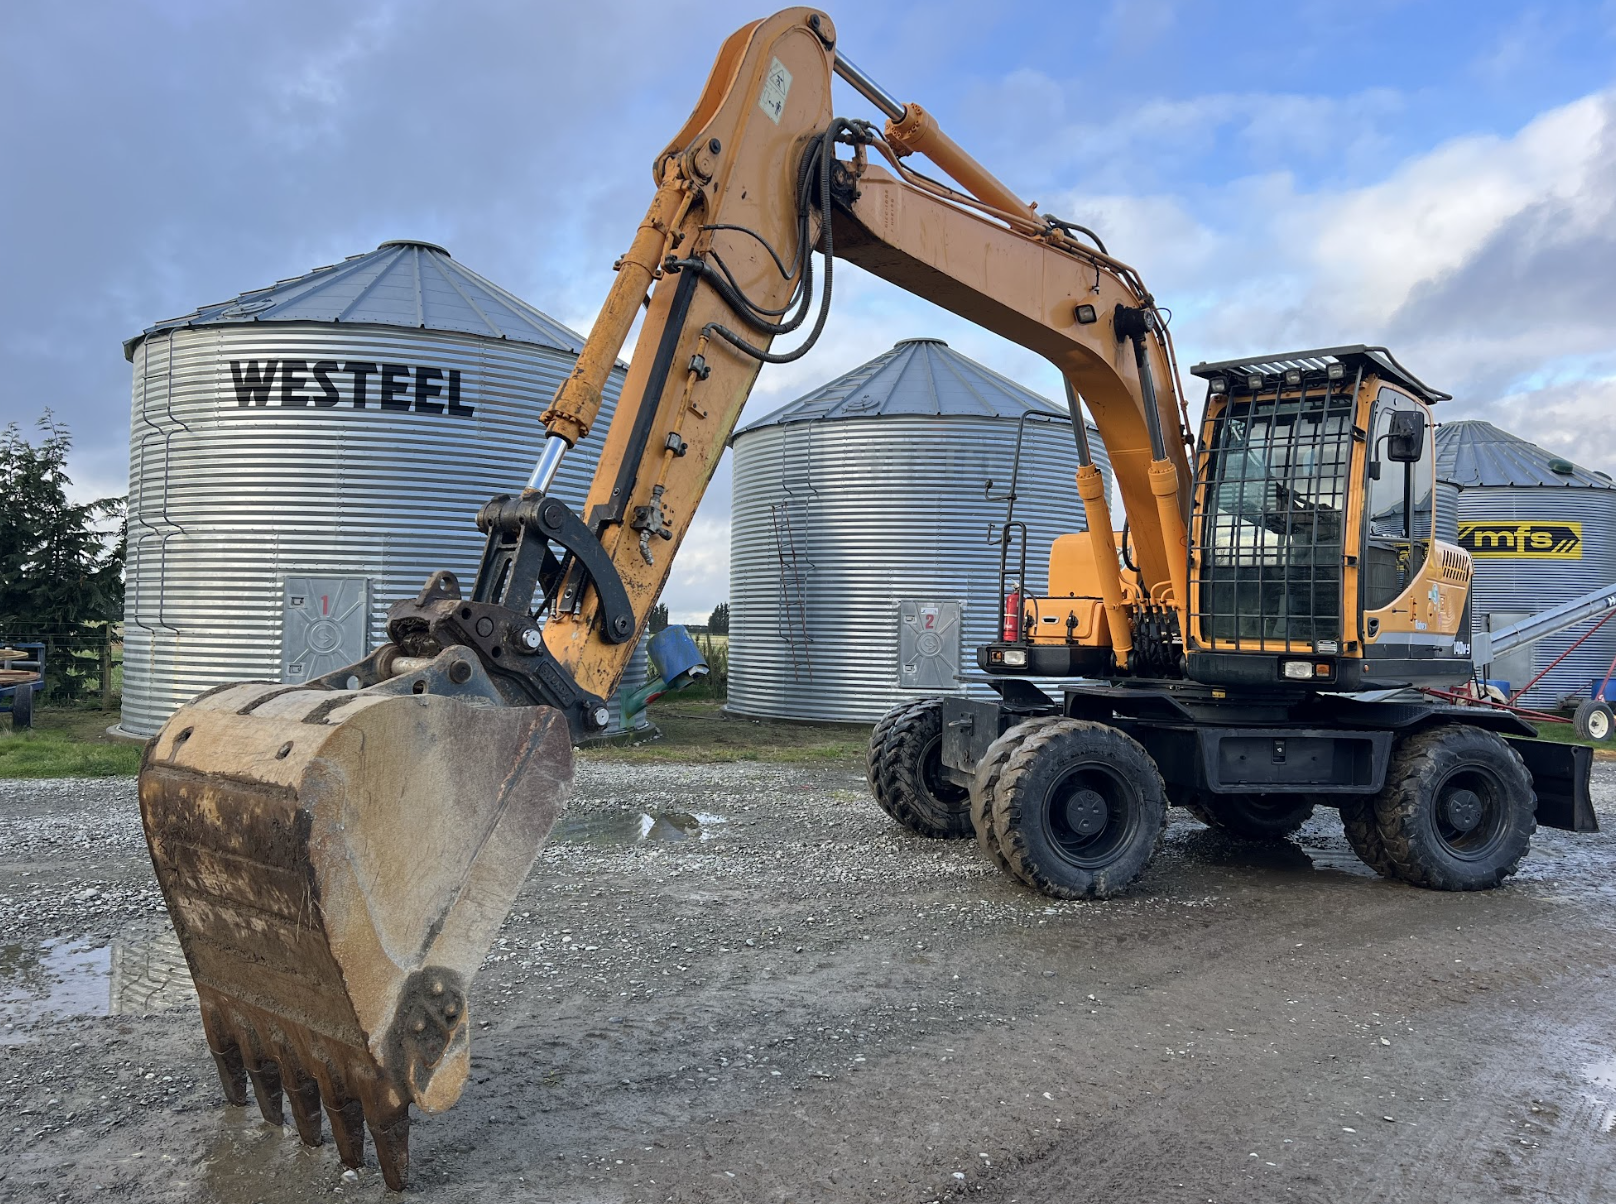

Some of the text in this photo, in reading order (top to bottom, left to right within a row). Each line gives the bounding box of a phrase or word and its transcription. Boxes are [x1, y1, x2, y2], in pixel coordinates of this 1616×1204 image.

[229, 360, 475, 417] WESTEEL
[1474, 526, 1552, 552] mfs
[320, 595, 329, 615] 1
[925, 614, 935, 629] 2
